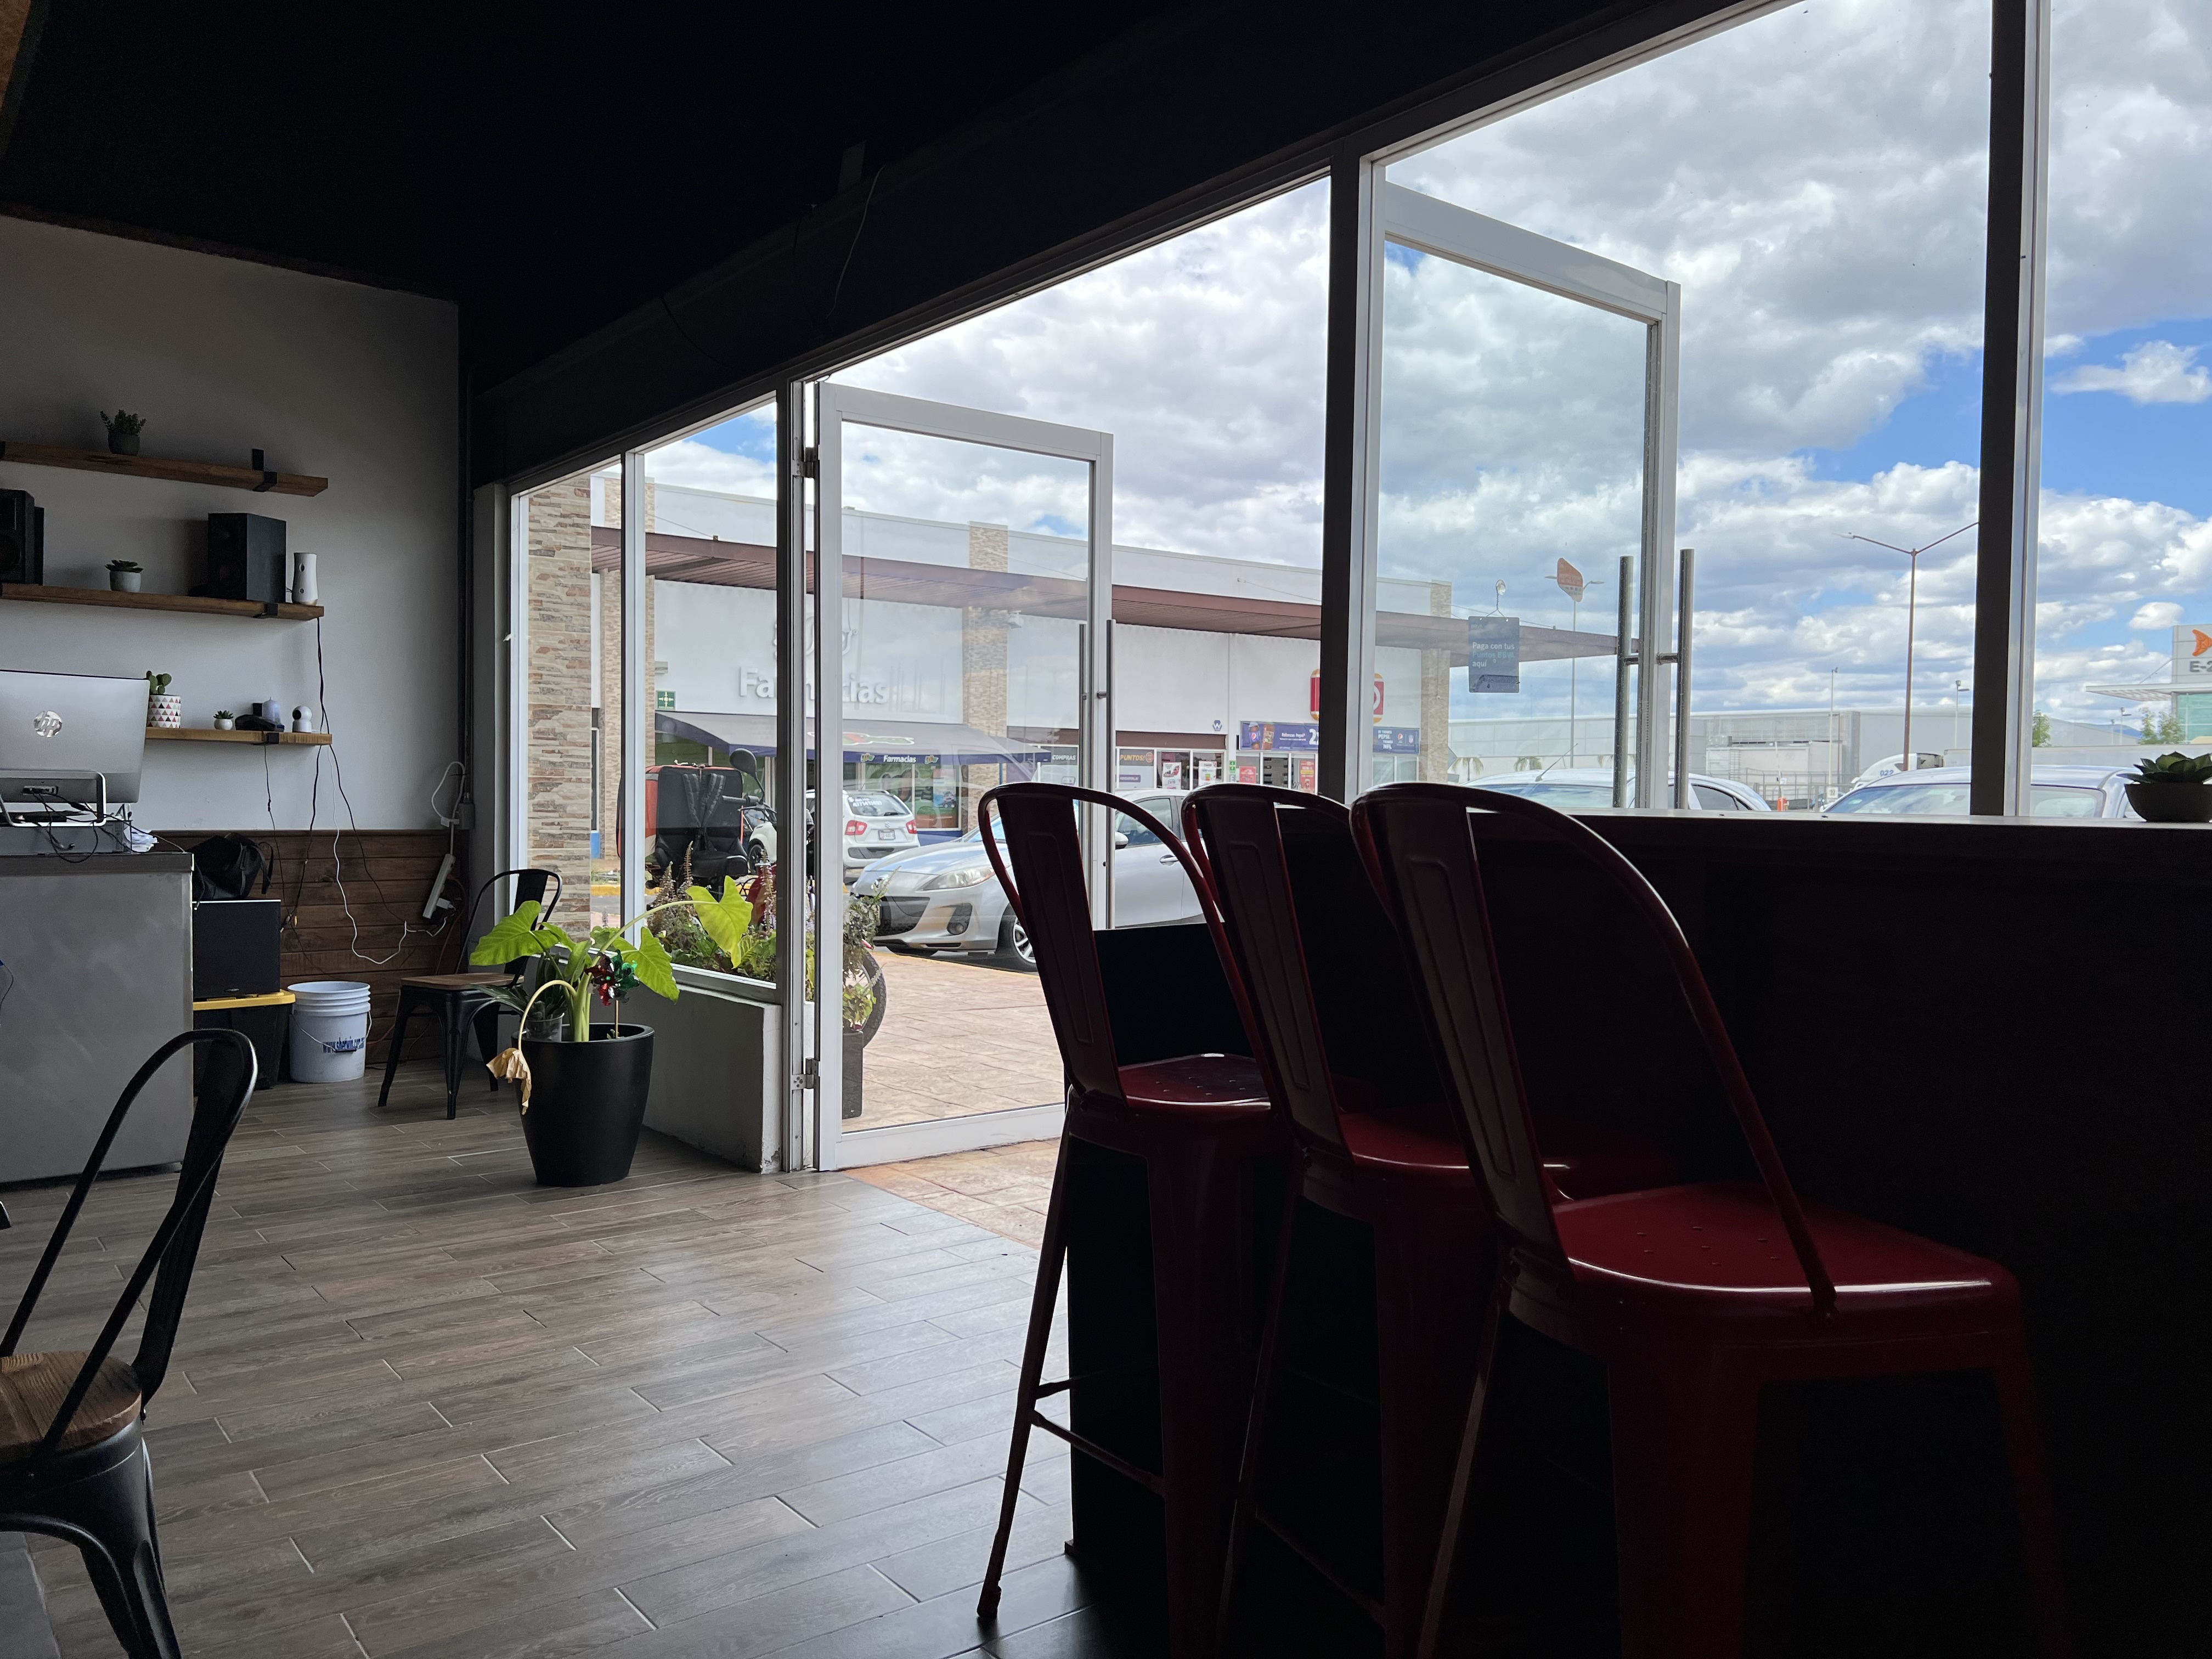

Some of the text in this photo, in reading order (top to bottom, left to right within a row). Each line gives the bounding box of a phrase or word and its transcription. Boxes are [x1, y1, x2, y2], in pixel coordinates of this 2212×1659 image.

[1472, 642, 1488, 651] Paga
[1472, 659, 1487, 668] aquí
[1309, 728, 1319, 745] 2
[883, 754, 917, 763] Farmacias
